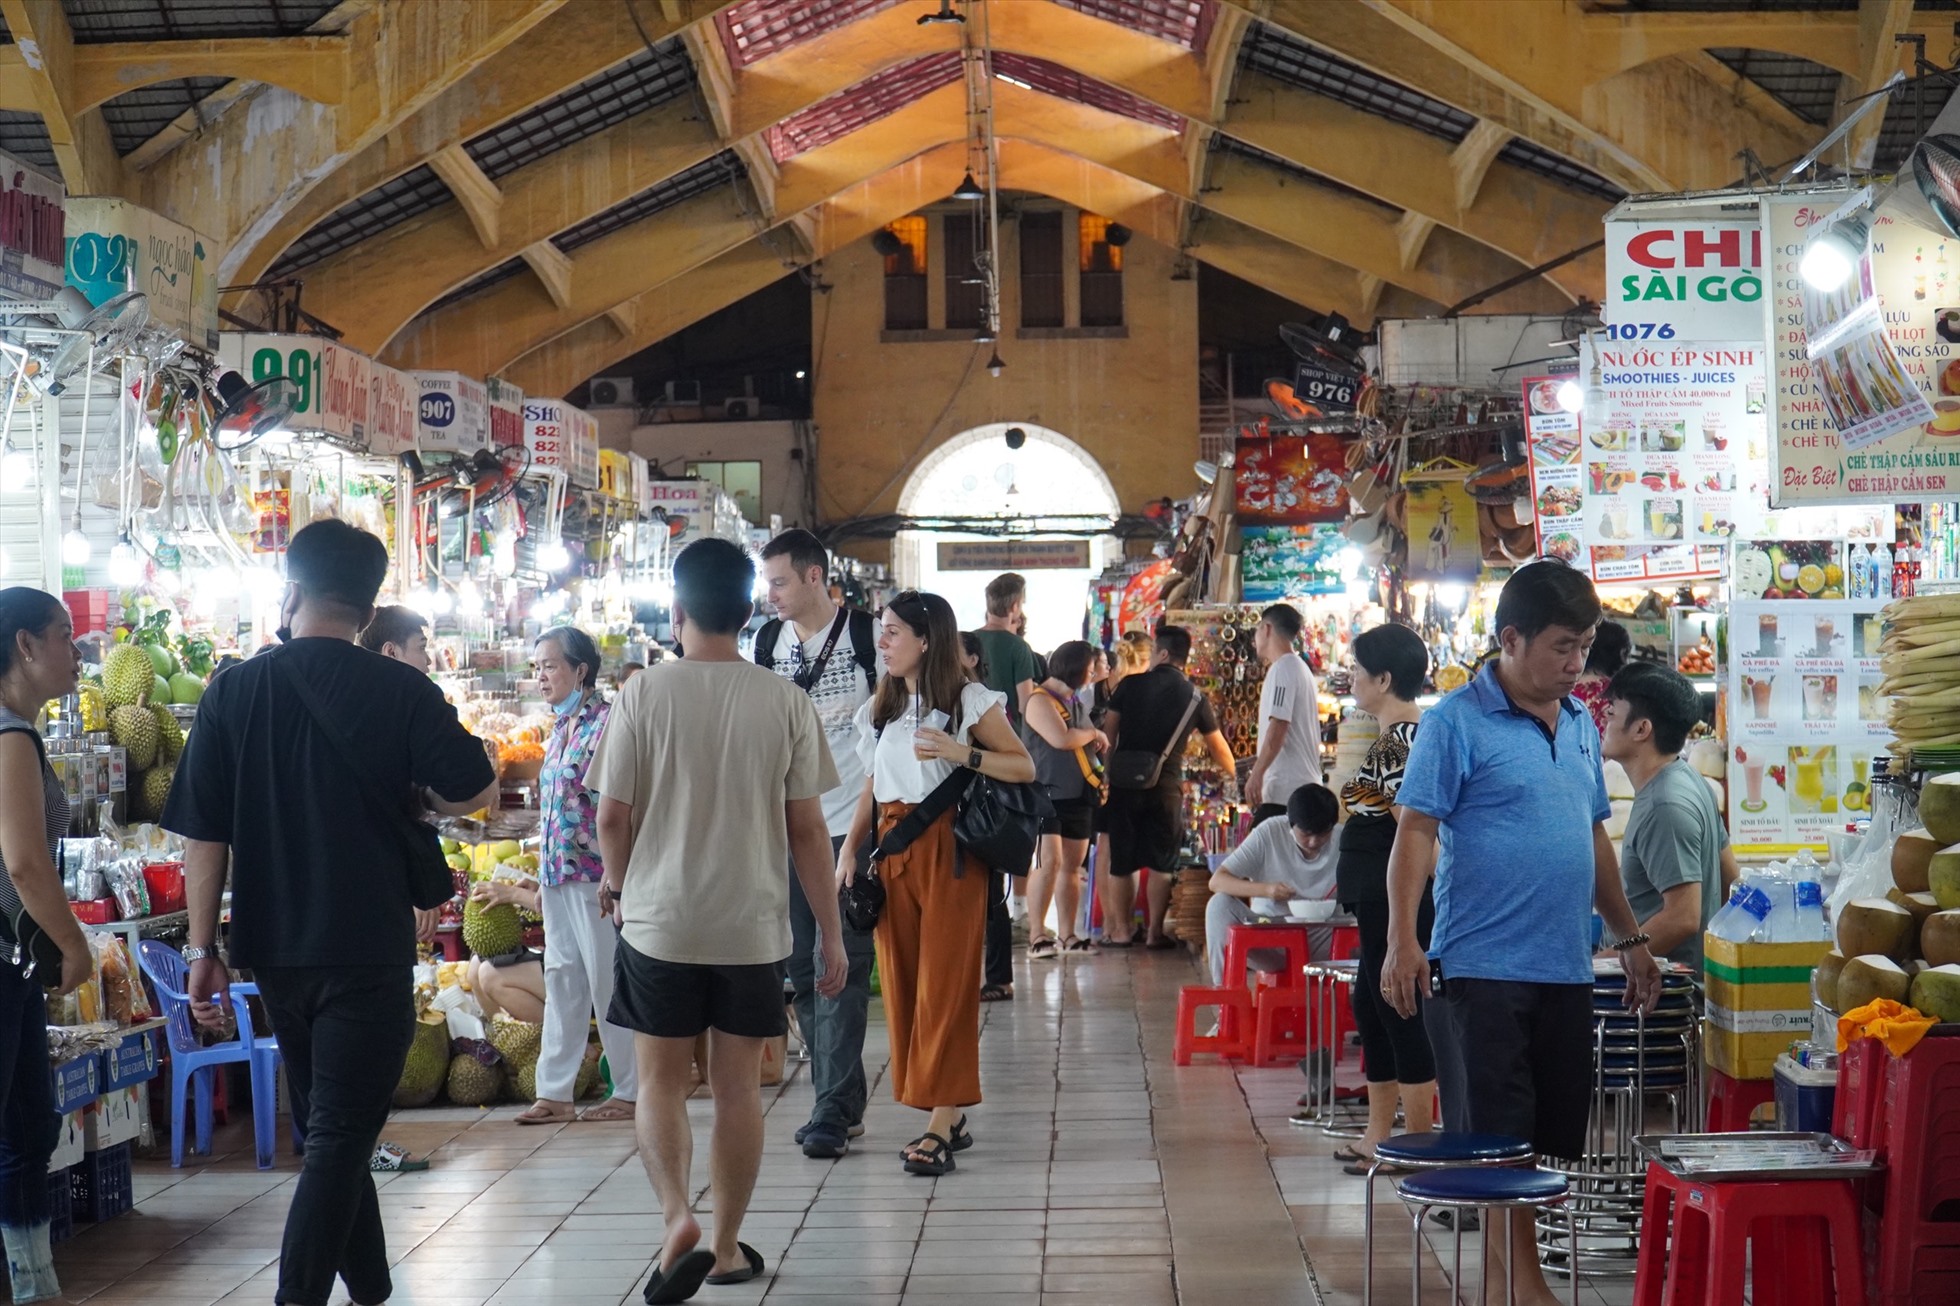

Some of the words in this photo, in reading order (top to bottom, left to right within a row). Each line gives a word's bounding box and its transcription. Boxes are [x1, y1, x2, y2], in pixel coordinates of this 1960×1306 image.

[1622, 269, 1687, 302] SÀI
[1607, 323, 1676, 340] 1076
[1903, 328, 1926, 343] LỌT
[1602, 346, 1665, 367] NƯỚC
[1671, 346, 1697, 367] ÉP
[1702, 351, 1754, 366] SINH
[1925, 341, 1950, 357] SÁO
[1301, 368, 1324, 379] SHOP
[1603, 372, 1680, 384] SMOOTHIES
[1691, 372, 1736, 383] JUICES
[1308, 381, 1351, 403] 976
[421, 400, 453, 419] 907
[1621, 400, 1645, 408] Mixed
[1646, 400, 1669, 408] Fruits
[1670, 399, 1704, 408] Smoothie
[1792, 416, 1819, 431] CHÈ
[431, 431, 446, 440] TEA
[1792, 435, 1819, 449] CHÈ
[1847, 451, 1868, 470] CHÈ
[1870, 450, 1898, 472] THẬP
[1900, 445, 1924, 468] CẨM
[1784, 467, 1808, 491] Đặc
[1812, 466, 1837, 490] Biệt
[1848, 473, 1869, 492] CHÈ
[1871, 472, 1899, 494] THẬP
[1901, 468, 1924, 491] CẨM
[1926, 475, 1946, 489] SEN
[652, 486, 699, 500] Hoa
